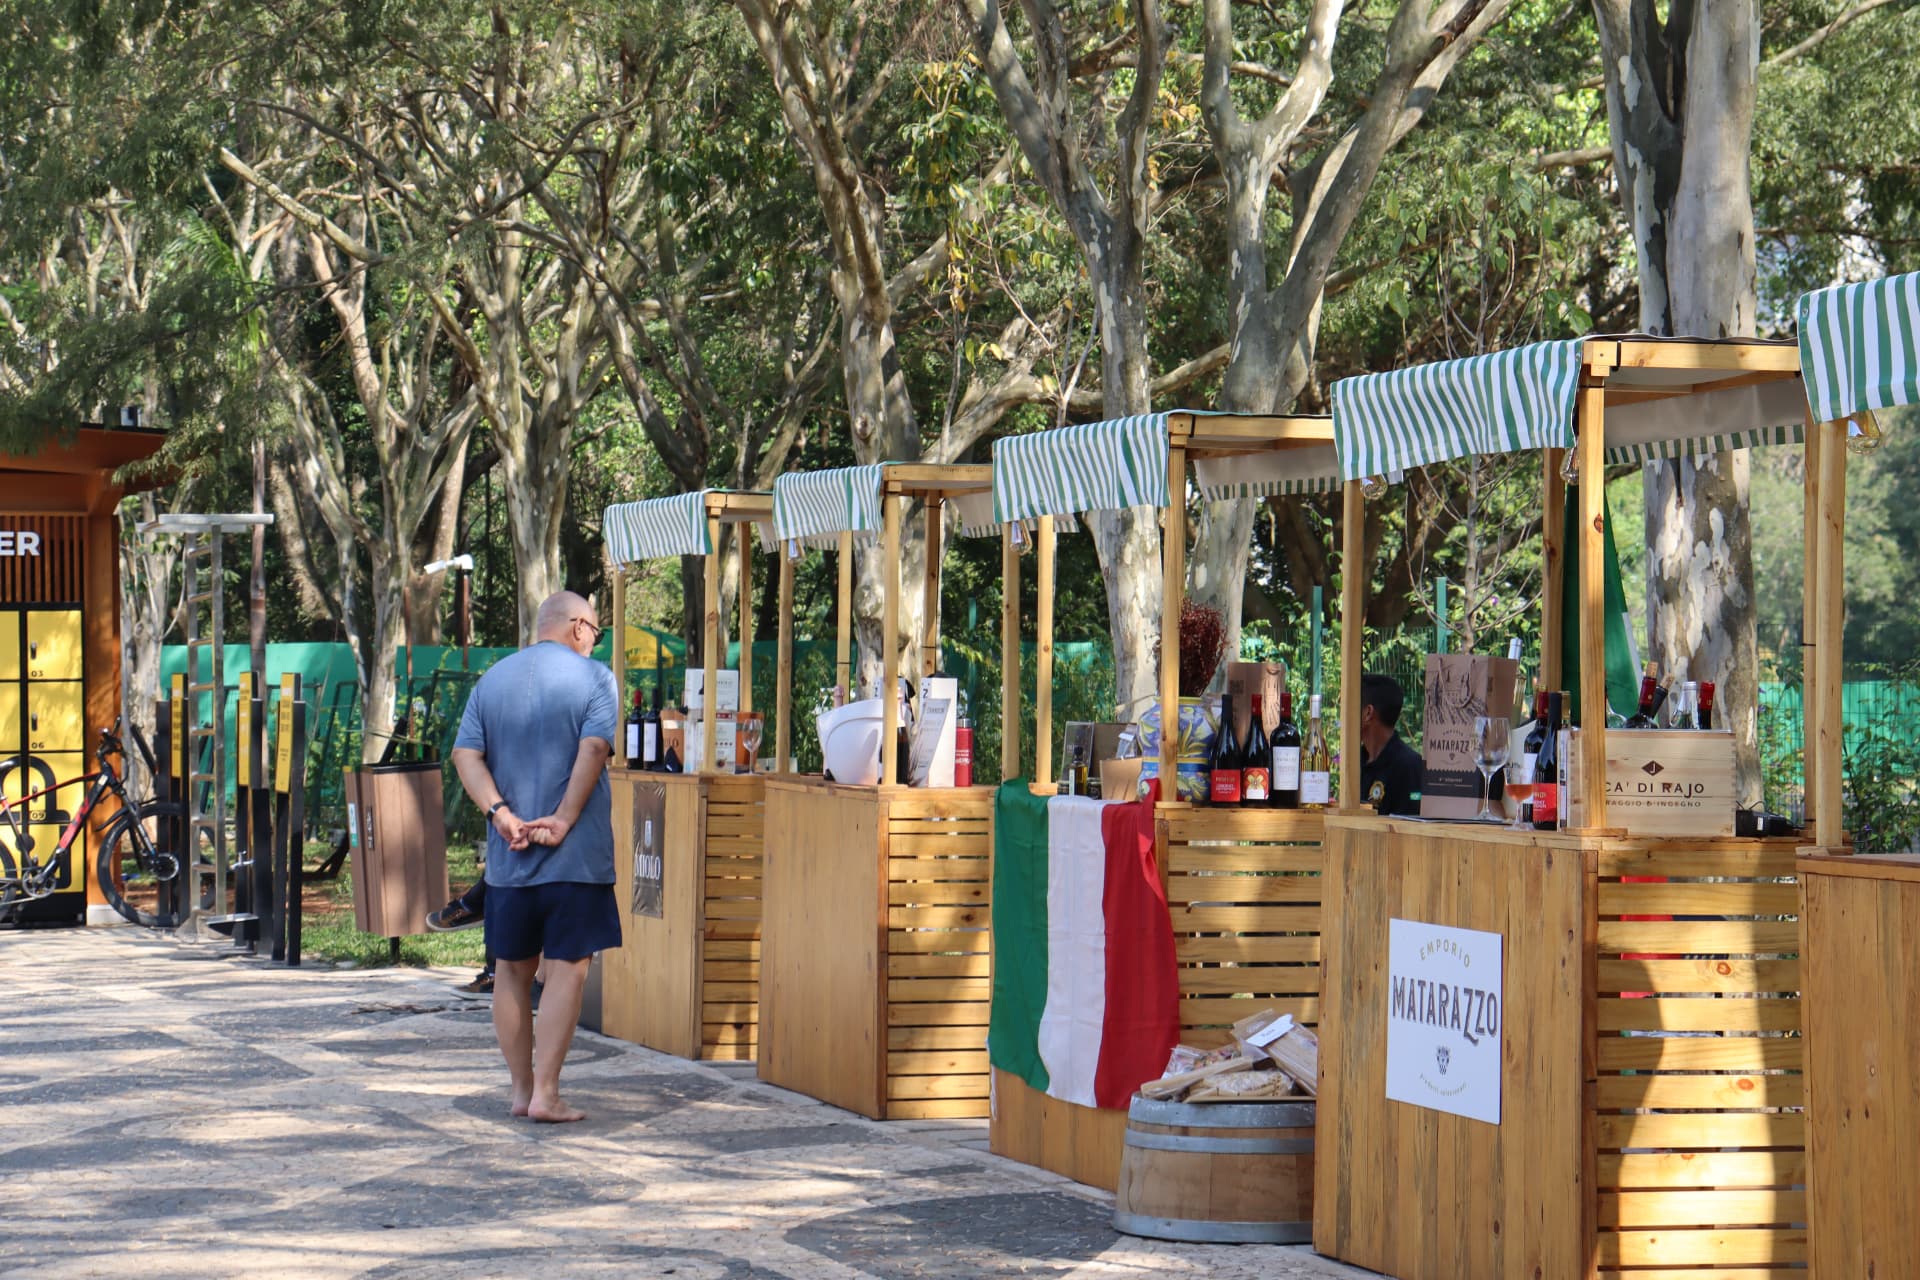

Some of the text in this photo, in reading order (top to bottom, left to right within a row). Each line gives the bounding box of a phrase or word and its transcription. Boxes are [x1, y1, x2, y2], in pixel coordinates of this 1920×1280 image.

[31, 670, 43, 678] 03
[31, 742, 44, 750] 06
[1638, 782, 1653, 793] DI
[1662, 782, 1705, 799] RAJO
[1420, 938, 1471, 968] EMPORIO
[1392, 975, 1498, 1047] MATARAZZO
